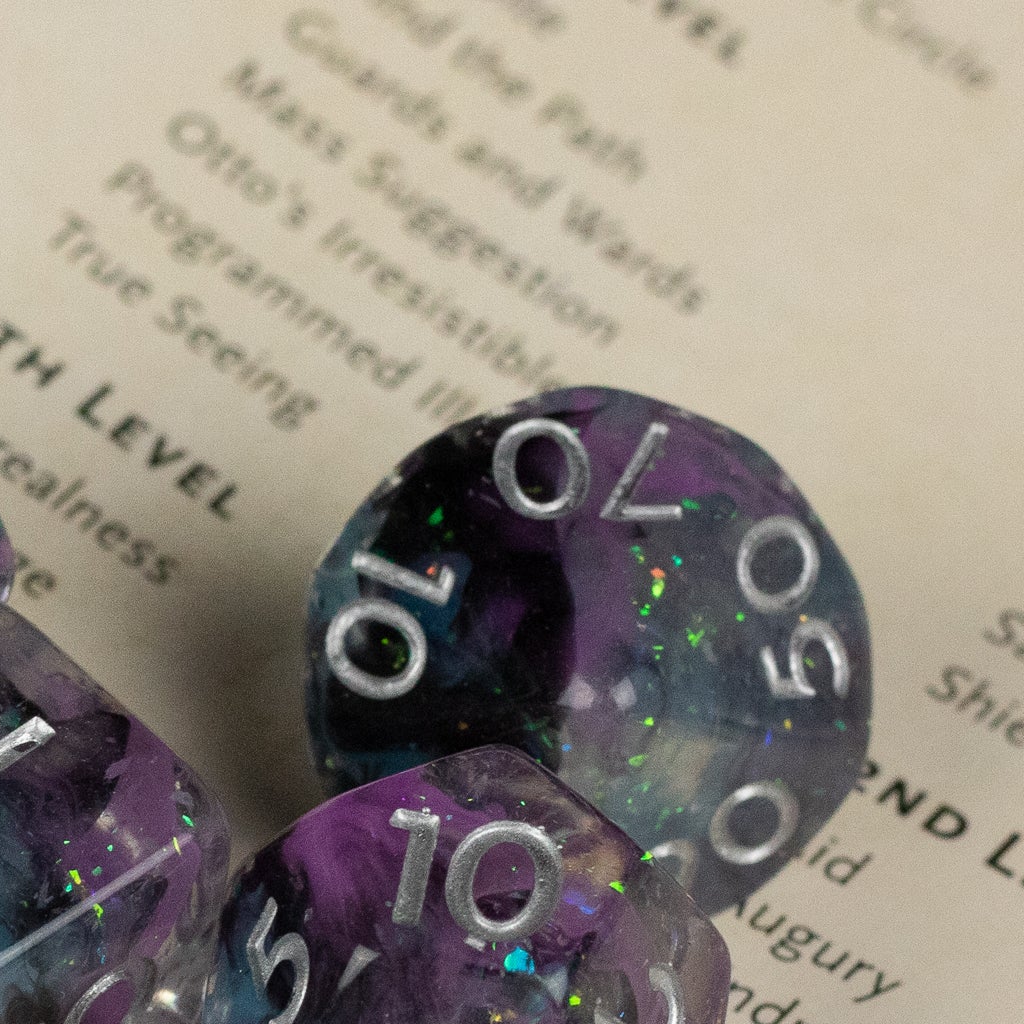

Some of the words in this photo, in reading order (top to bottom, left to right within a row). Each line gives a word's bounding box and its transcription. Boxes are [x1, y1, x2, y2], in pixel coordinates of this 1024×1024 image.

[165, 108, 312, 230] Otto's
[224, 58, 348, 164] Mass
[352, 148, 622, 350] Suggestion
[453, 136, 564, 212] and
[562, 190, 708, 316] Wards
[48, 211, 154, 306] True
[154, 297, 320, 432] Seeing
[106, 160, 422, 391] Programmed
[75, 380, 242, 522] LEVEL
[388, 806, 566, 954] 10
[800, 836, 874, 886] id
